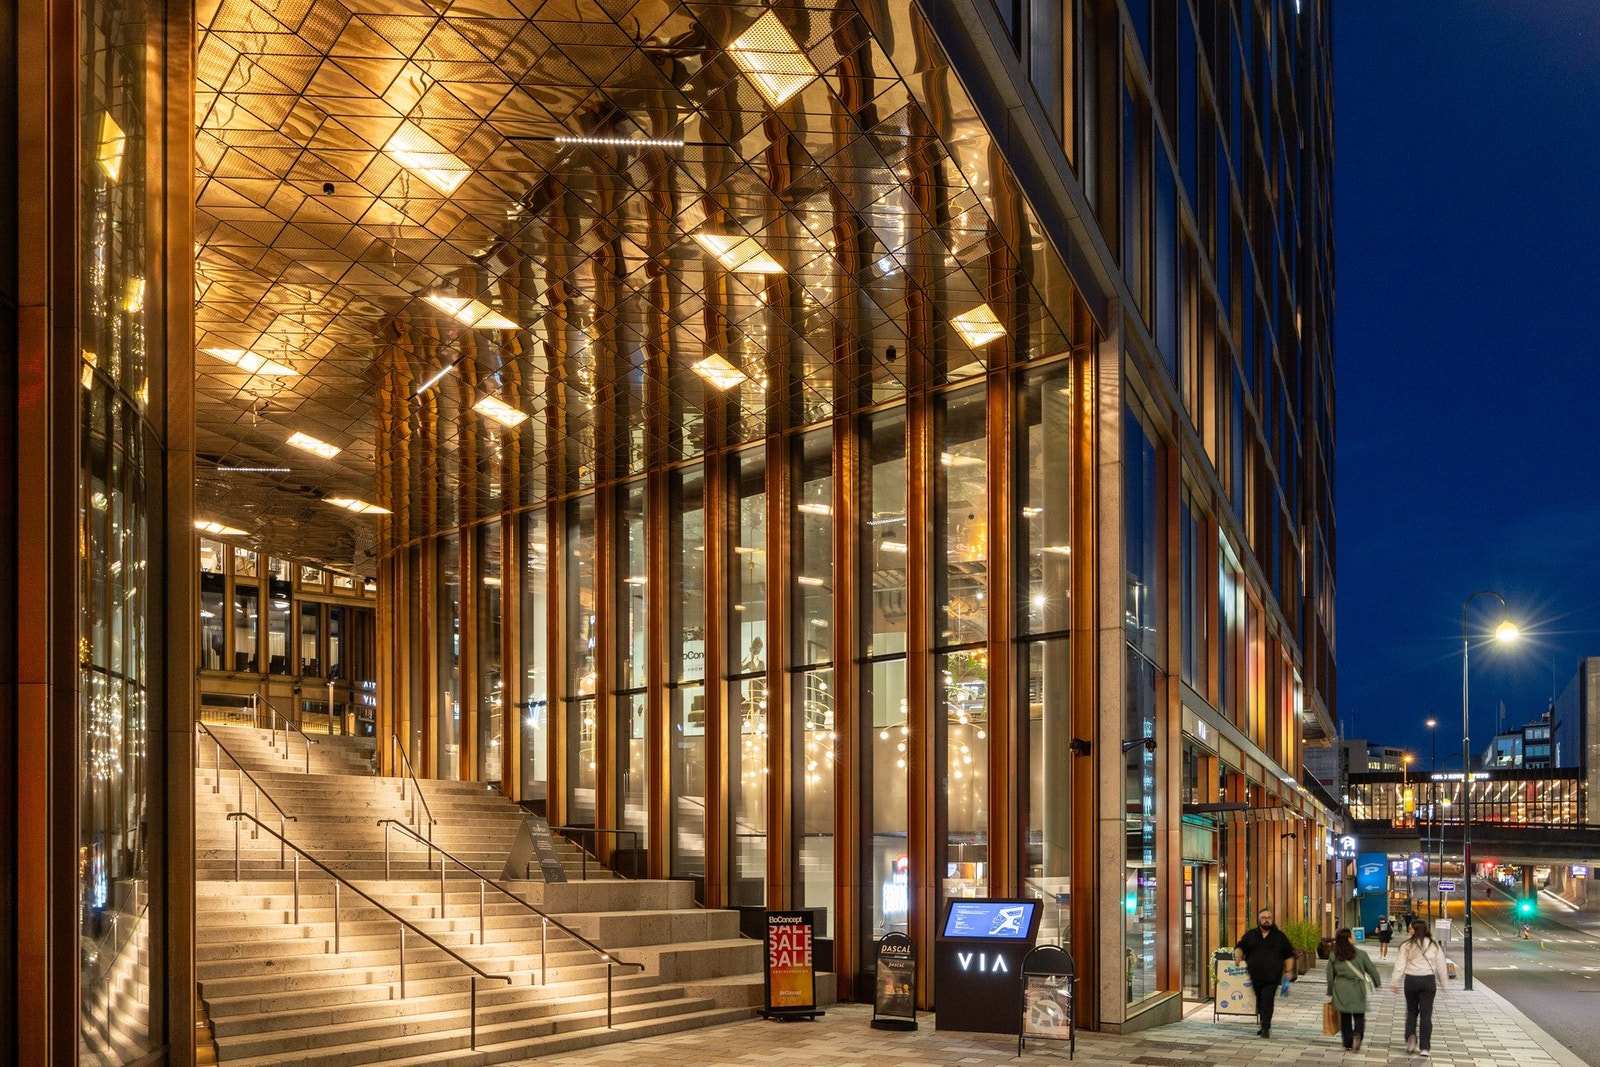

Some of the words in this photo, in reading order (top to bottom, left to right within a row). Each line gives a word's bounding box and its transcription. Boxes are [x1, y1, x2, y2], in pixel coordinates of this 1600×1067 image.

[1365, 866, 1379, 875] P
[769, 916, 802, 924] BoConcept
[769, 934, 812, 951] SALE
[769, 951, 812, 968] SALE
[957, 953, 1008, 972] VIA
